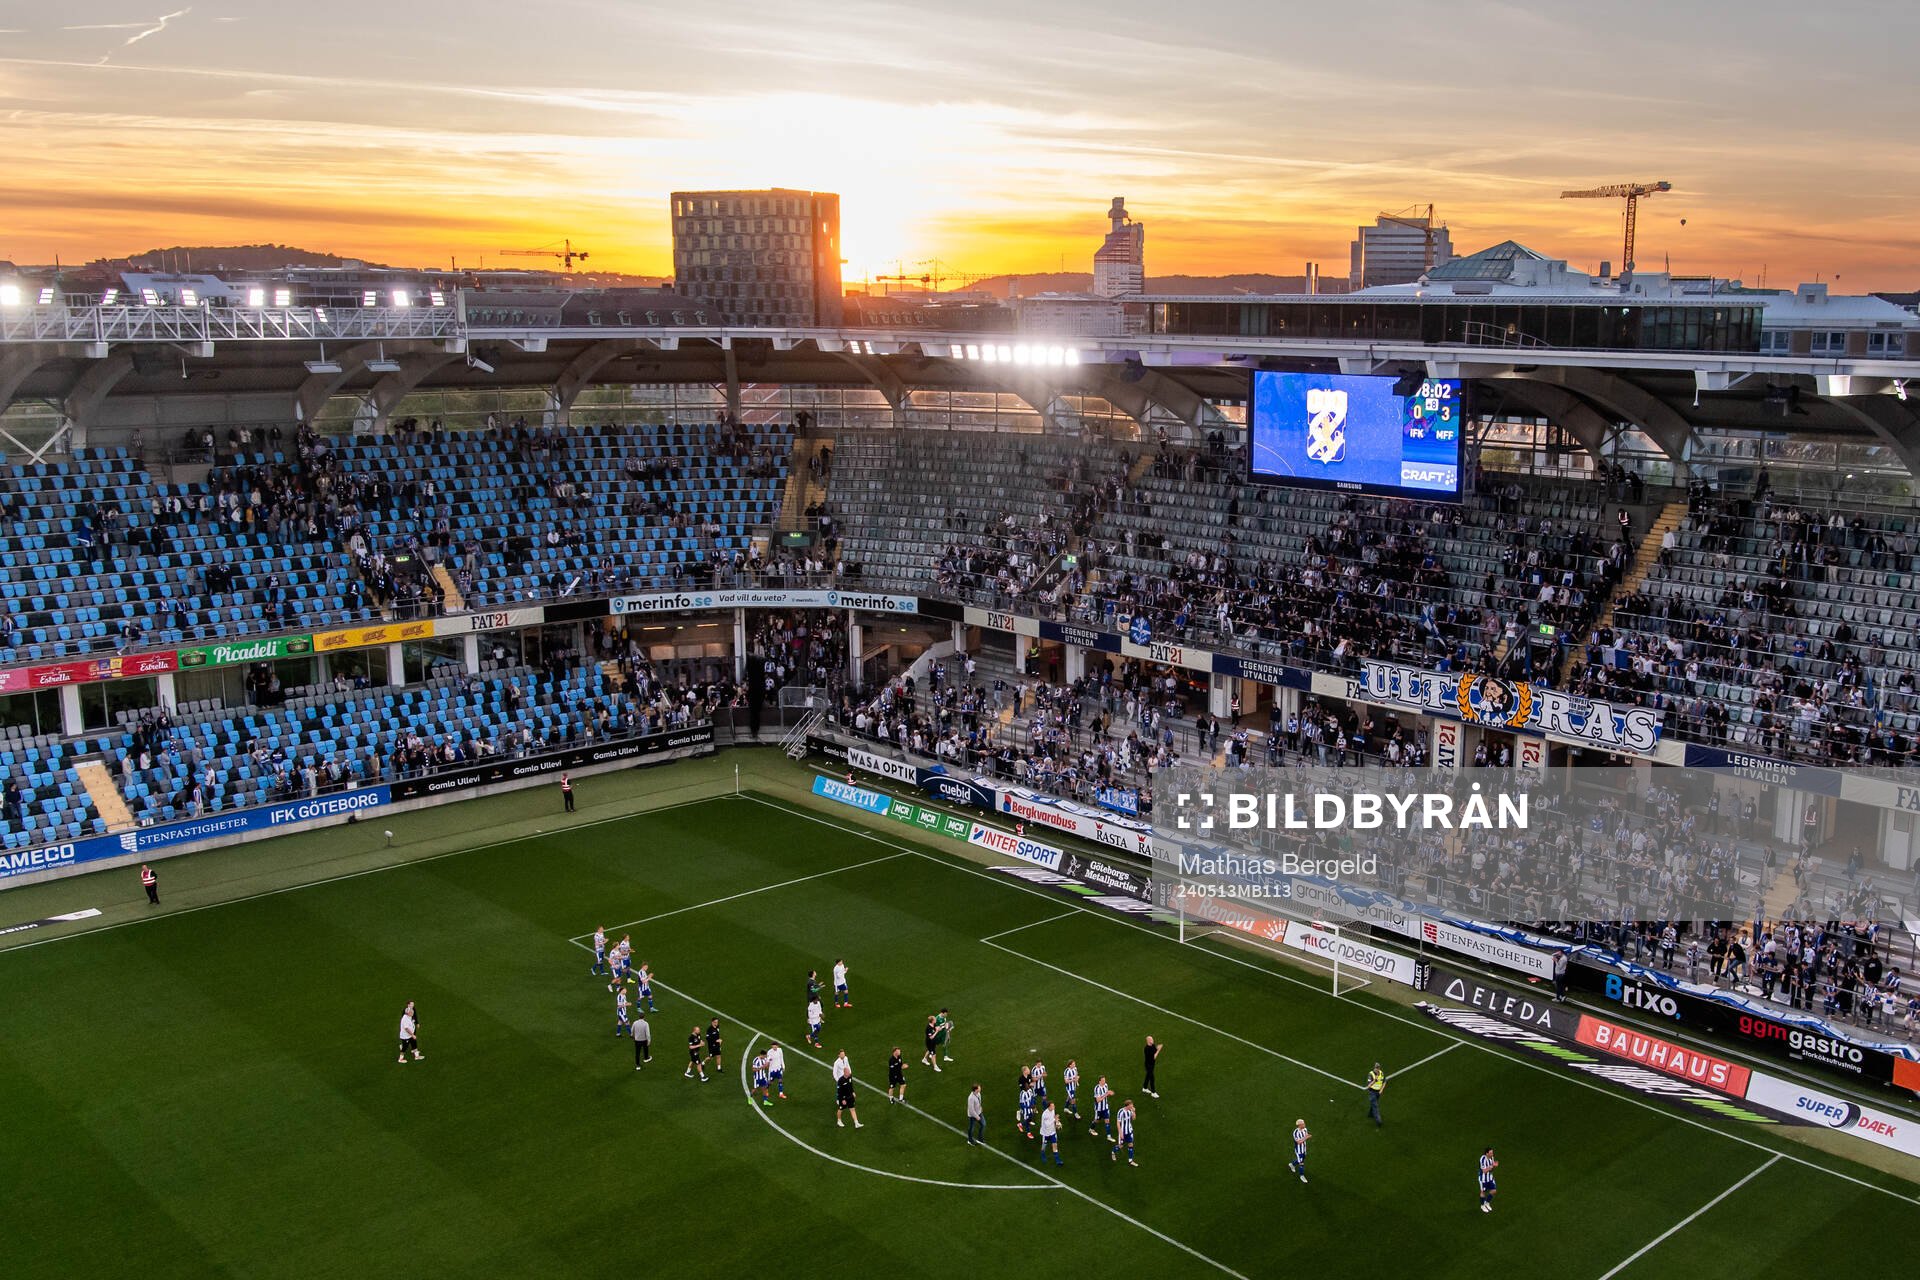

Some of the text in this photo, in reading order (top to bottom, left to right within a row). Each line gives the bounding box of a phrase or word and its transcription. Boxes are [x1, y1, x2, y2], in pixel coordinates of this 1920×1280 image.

[1415, 383, 1451, 399] 8:02
[1413, 405, 1422, 419] 0
[1441, 406, 1450, 421] 3
[1410, 429, 1424, 438] IFK
[1436, 431, 1454, 440] MFF
[1401, 469, 1445, 483] CRAFT
[1336, 481, 1362, 490] SAMSUNG
[627, 594, 713, 611] merinfo.se
[719, 594, 735, 602] Vad
[737, 594, 749, 602] vill
[751, 594, 762, 602] du
[841, 595, 914, 611] merinfo.se
[471, 612, 510, 630] FAT21
[987, 612, 1015, 631] FAT21
[1061, 626, 1099, 640] LEGENDENS
[1065, 635, 1094, 648] UTVALDA
[213, 640, 277, 663] Picadeli
[1150, 642, 1183, 665] FAT21
[1513, 646, 1527, 660] H4
[140, 662, 169, 672] Estrella
[1238, 659, 1284, 677] LEGENDENS
[39, 673, 71, 684] Estrella
[1243, 669, 1278, 684] UTVALDA
[1365, 661, 1658, 752] ULT RAS
[668, 732, 711, 746] Gamla Ullevi
[593, 749, 617, 760] Gamla
[618, 745, 639, 755] Ullevi
[513, 766, 539, 775] Gamla
[540, 759, 562, 770] Ullevi
[850, 750, 915, 781] WASA OPTIK
[1727, 753, 1797, 776] LEGENDENS
[428, 781, 455, 791] Gamla
[457, 774, 480, 786] Ullevi
[1733, 767, 1788, 786] UTVALDA
[939, 782, 971, 801] cuebid
[271, 793, 379, 824] IFK GÖTEBORG
[894, 803, 910, 817] MCR
[1012, 801, 1077, 831] Bergkvarabuss
[920, 812, 937, 826] MCR
[948, 820, 965, 834] MCR
[139, 818, 248, 845] STENFASTIGHETER
[1096, 830, 1128, 849] RASTA
[983, 830, 1058, 866] INTERSPORT
[1138, 842, 1171, 862] RASTA
[1089, 860, 1130, 881] Göteborgs
[1084, 869, 1138, 893] Metallpartier
[1198, 897, 1255, 931] Renova
[1439, 930, 1543, 969] STENFASTIGHETER
[1473, 987, 1551, 1028] ELEDA
[1595, 1024, 1727, 1083] BAUHAUS
[1796, 1096, 1843, 1121] SUPER
